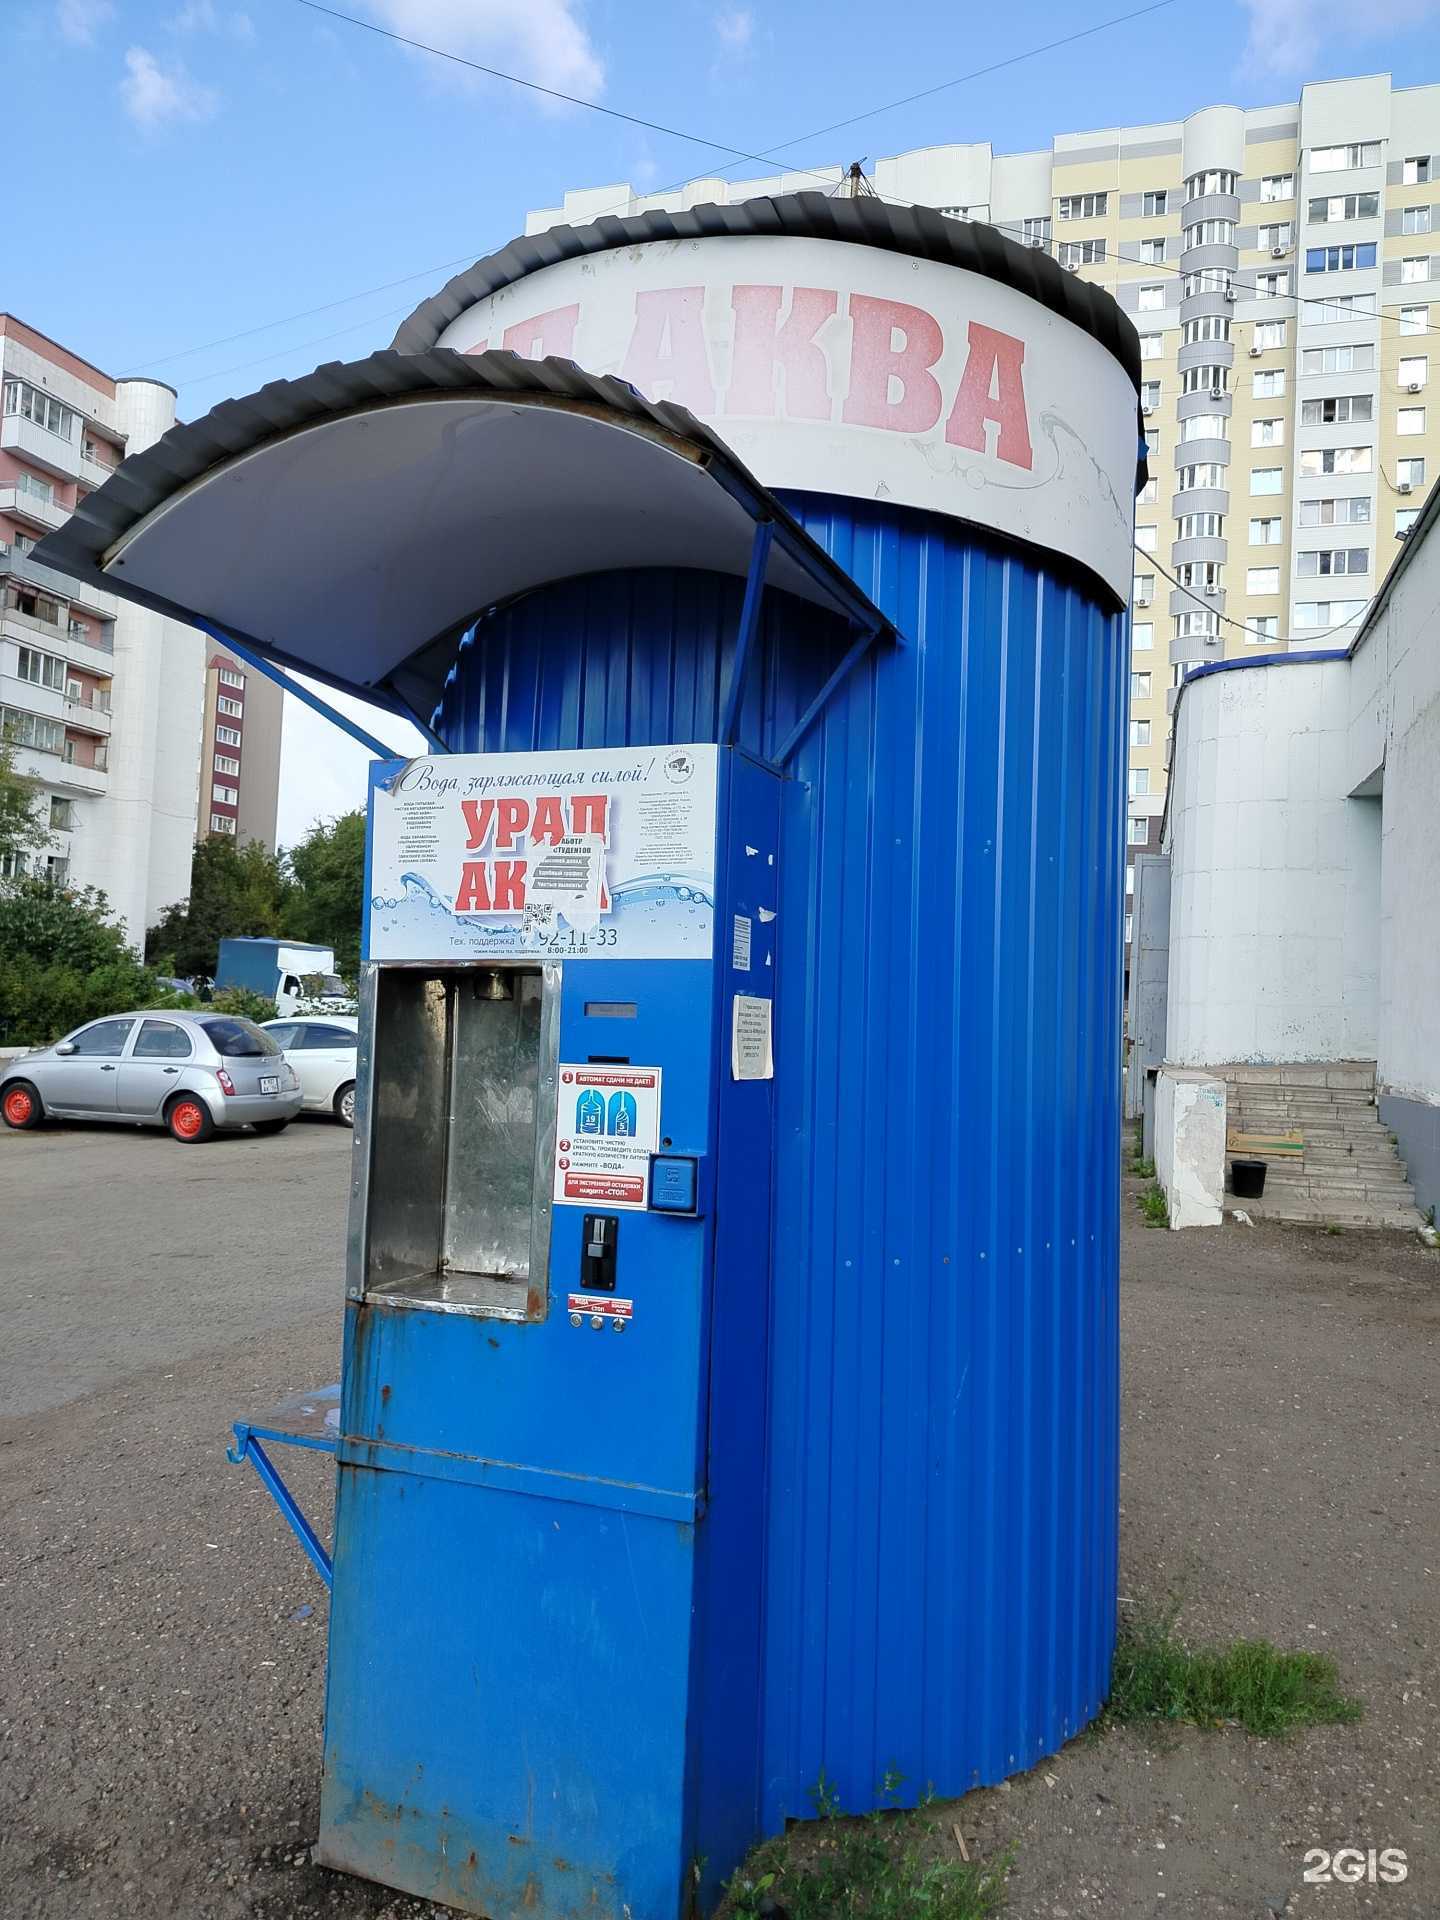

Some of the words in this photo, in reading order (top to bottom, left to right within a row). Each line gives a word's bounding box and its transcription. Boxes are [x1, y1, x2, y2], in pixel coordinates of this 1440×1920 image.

[621, 285, 1032, 471] АКВА
[400, 765, 460, 797] Вода,
[463, 771, 584, 795] заряжающая
[592, 757, 656, 784] силой!
[461, 795, 608, 850] УРАП
[455, 860, 608, 911] АК
[449, 936, 466, 946] Тех.
[469, 937, 515, 947] поддержка
[547, 946, 588, 954] 8:00-21:00
[585, 1115, 596, 1123] 19
[619, 1122, 625, 1130] 5
[561, 1141, 568, 1150] 2
[560, 1160, 568, 1168] 3
